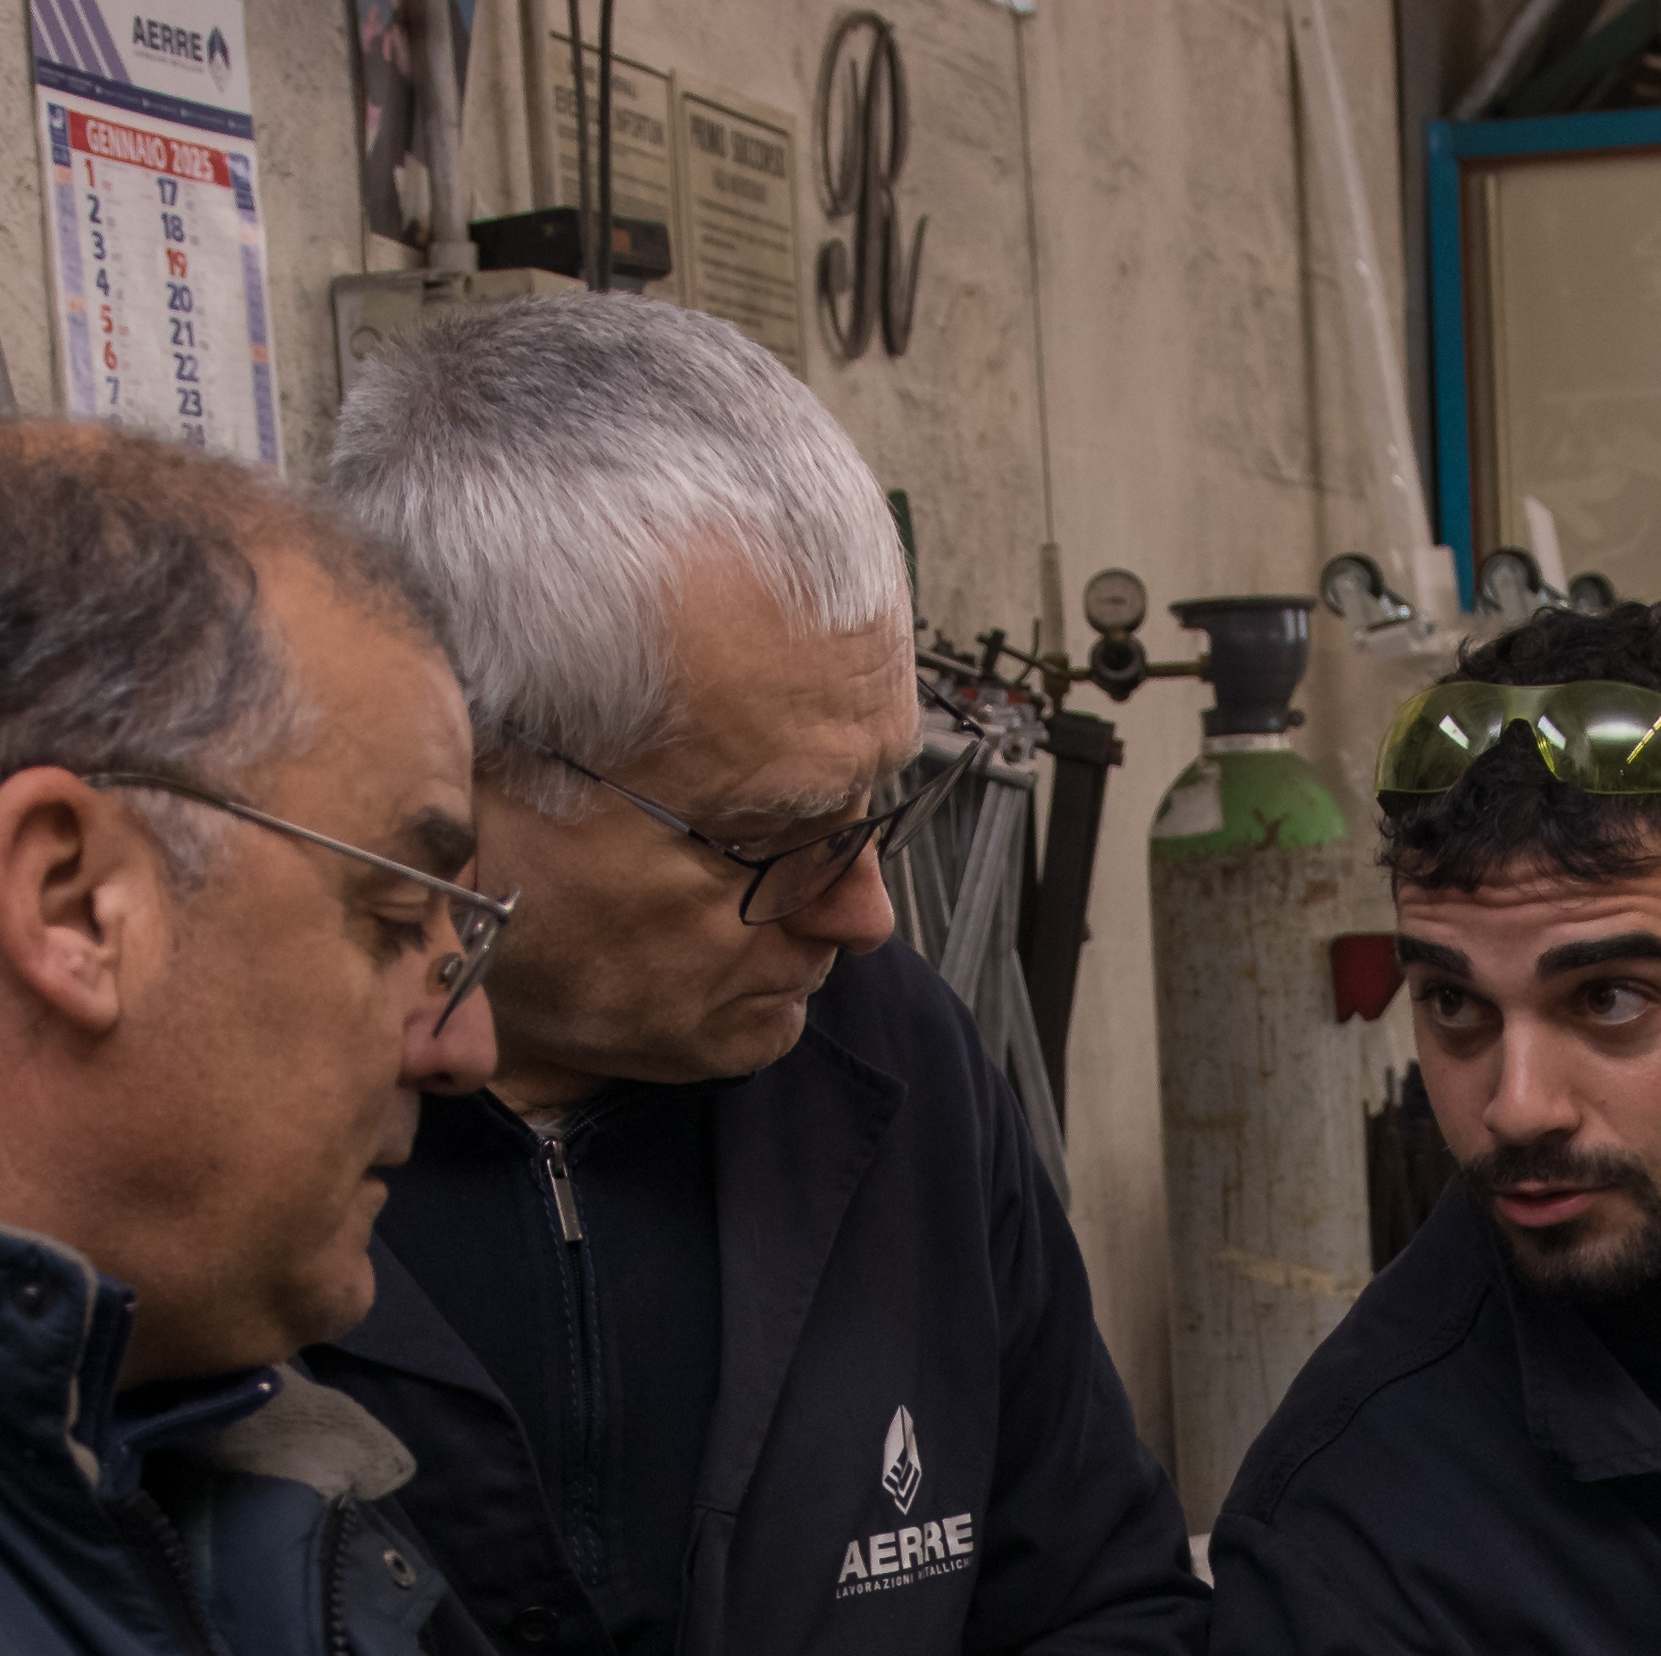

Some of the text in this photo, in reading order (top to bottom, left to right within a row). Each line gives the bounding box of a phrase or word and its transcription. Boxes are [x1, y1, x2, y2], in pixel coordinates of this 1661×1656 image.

[132, 15, 204, 63] AERRE
[85, 118, 216, 184] GENNAIO 2025
[84, 157, 95, 188] 1
[156, 176, 178, 207] 17
[86, 193, 102, 225] 2
[161, 211, 185, 243] 18
[91, 229, 106, 261] 3
[165, 247, 187, 279] 19
[95, 266, 110, 297] 4
[166, 281, 194, 313] 20
[100, 303, 114, 334] 5
[169, 316, 194, 347] 21
[103, 340, 118, 371] 6
[173, 351, 200, 383] 22
[105, 375, 120, 405] 7
[177, 386, 202, 417] 23
[837, 1512, 974, 1584] AERRE
[836, 1572, 914, 1599] LAVORAZIONI
